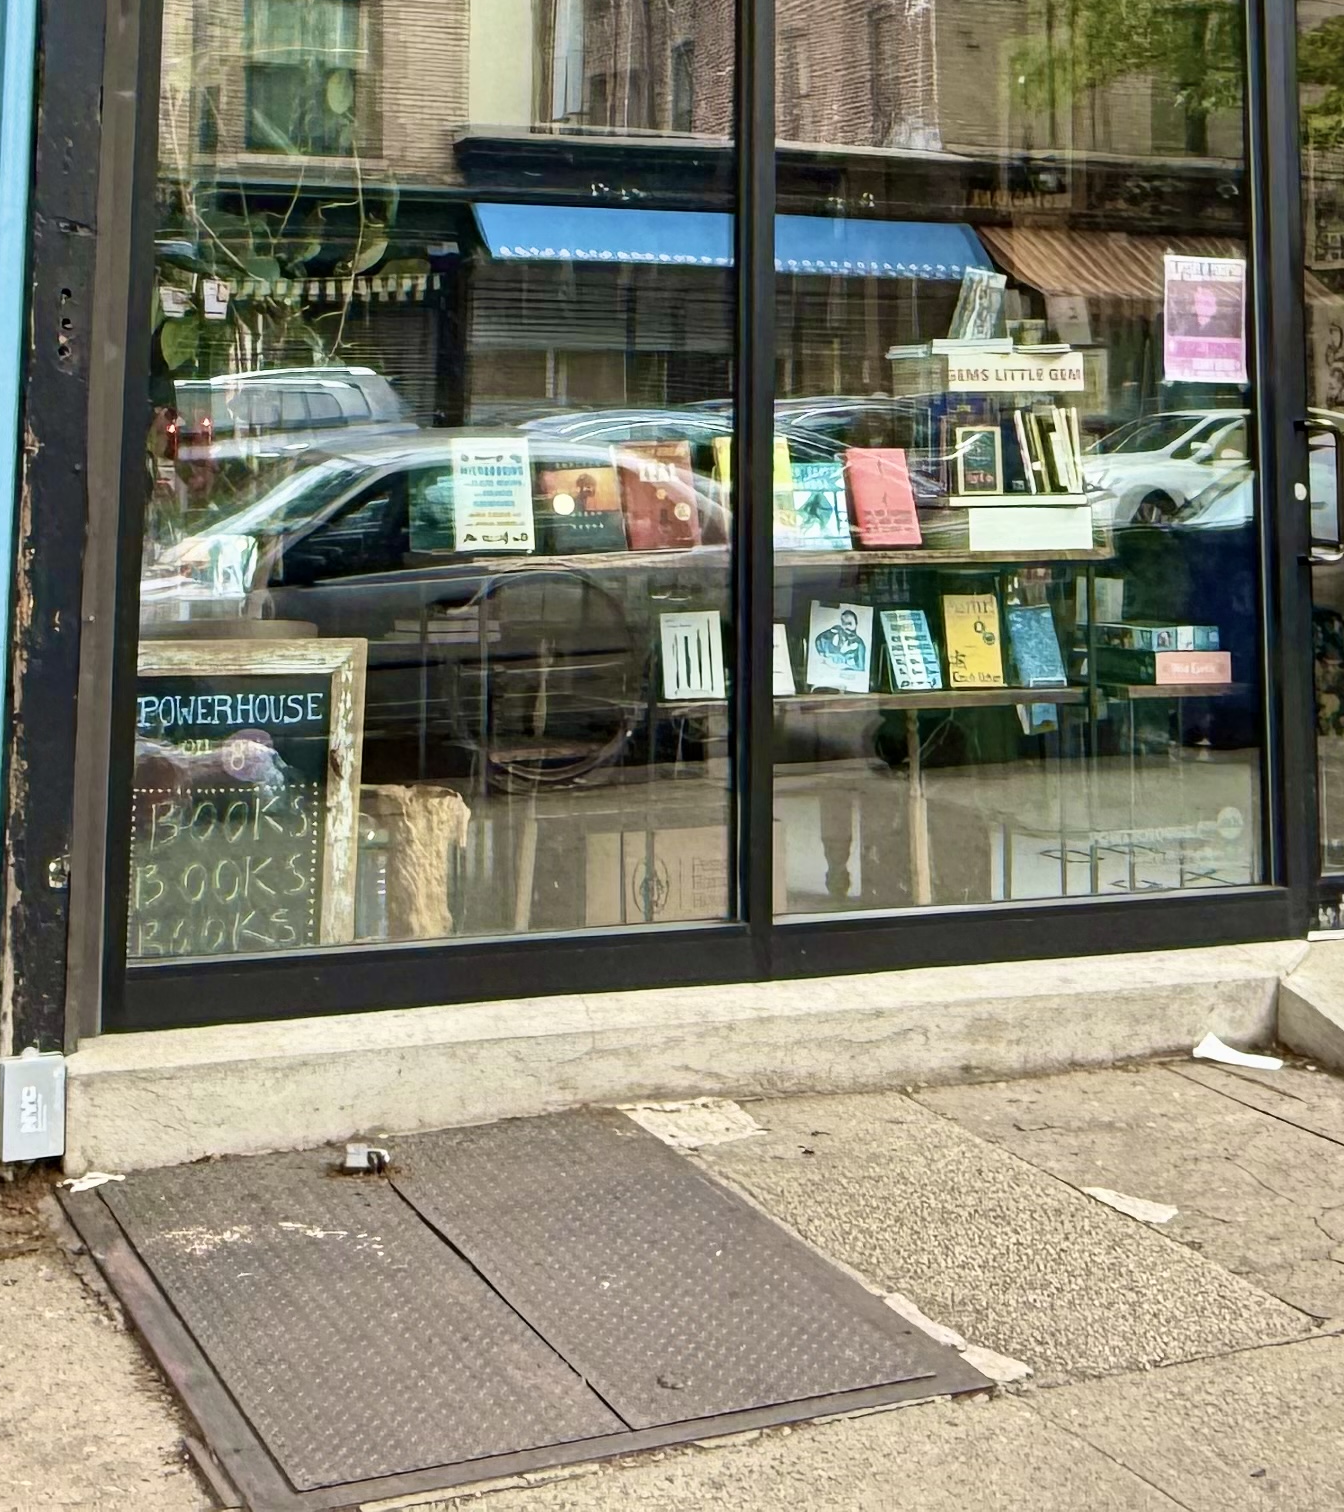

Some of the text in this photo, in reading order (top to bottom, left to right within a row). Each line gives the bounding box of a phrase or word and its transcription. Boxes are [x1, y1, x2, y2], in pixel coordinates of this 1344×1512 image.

[995, 367, 1044, 382] LITTLE
[136, 692, 324, 728] POWERHOUSE
[150, 796, 308, 851] BOOKS
[135, 853, 306, 910] BOOKS
